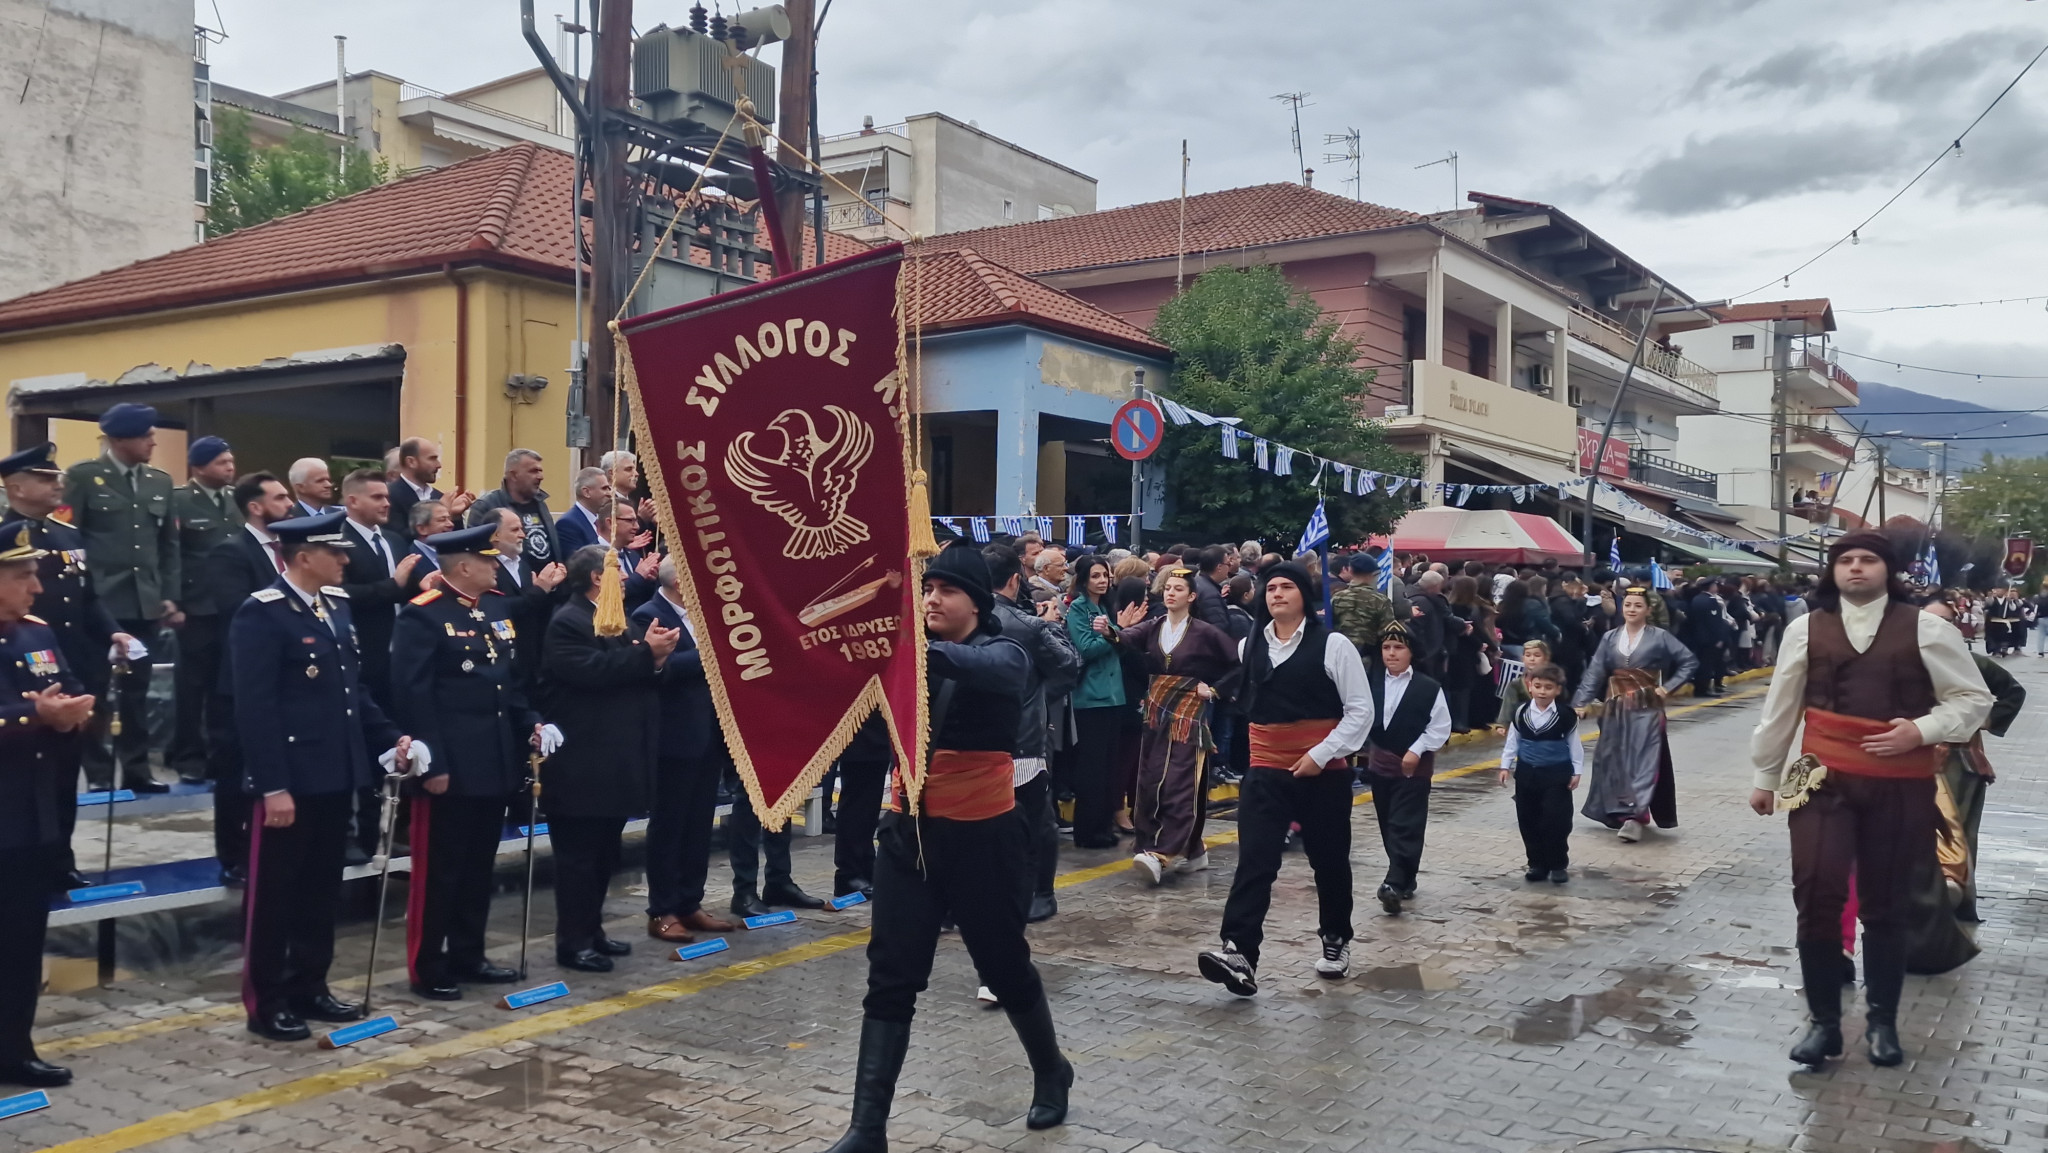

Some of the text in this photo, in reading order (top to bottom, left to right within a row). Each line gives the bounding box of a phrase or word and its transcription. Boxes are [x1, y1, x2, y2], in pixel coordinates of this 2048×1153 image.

[1578, 430, 1615, 465] ΣΥΡΖΑ
[676, 318, 857, 681] ΜΟΡΦΩΤΙΚΟΣ ΣΥΛΛΟΓΟΣ
[799, 625, 841, 650] ΕΤΟΣ
[840, 636, 892, 662] 1983
